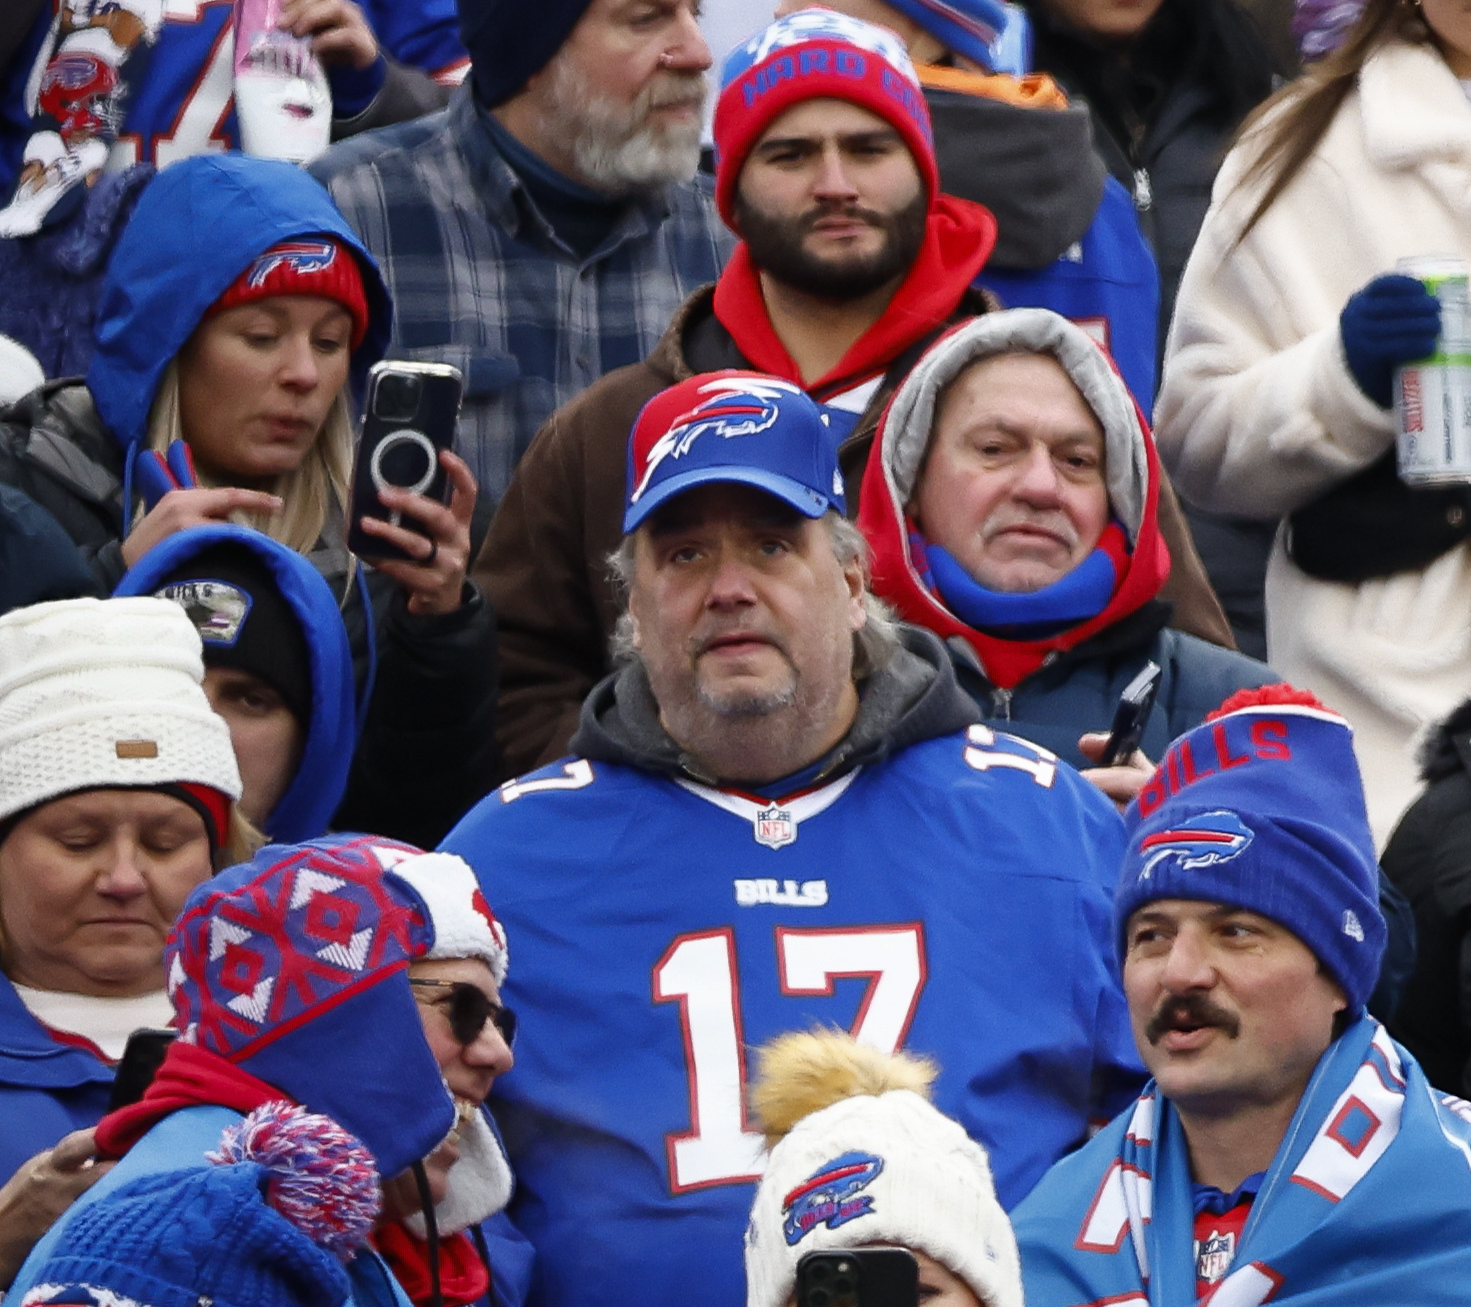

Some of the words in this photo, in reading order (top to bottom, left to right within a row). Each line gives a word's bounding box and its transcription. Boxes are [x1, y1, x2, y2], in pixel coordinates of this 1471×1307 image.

[1138, 718, 1293, 820] BILLS
[757, 818, 791, 838] NFL
[735, 878, 829, 906] BILLS
